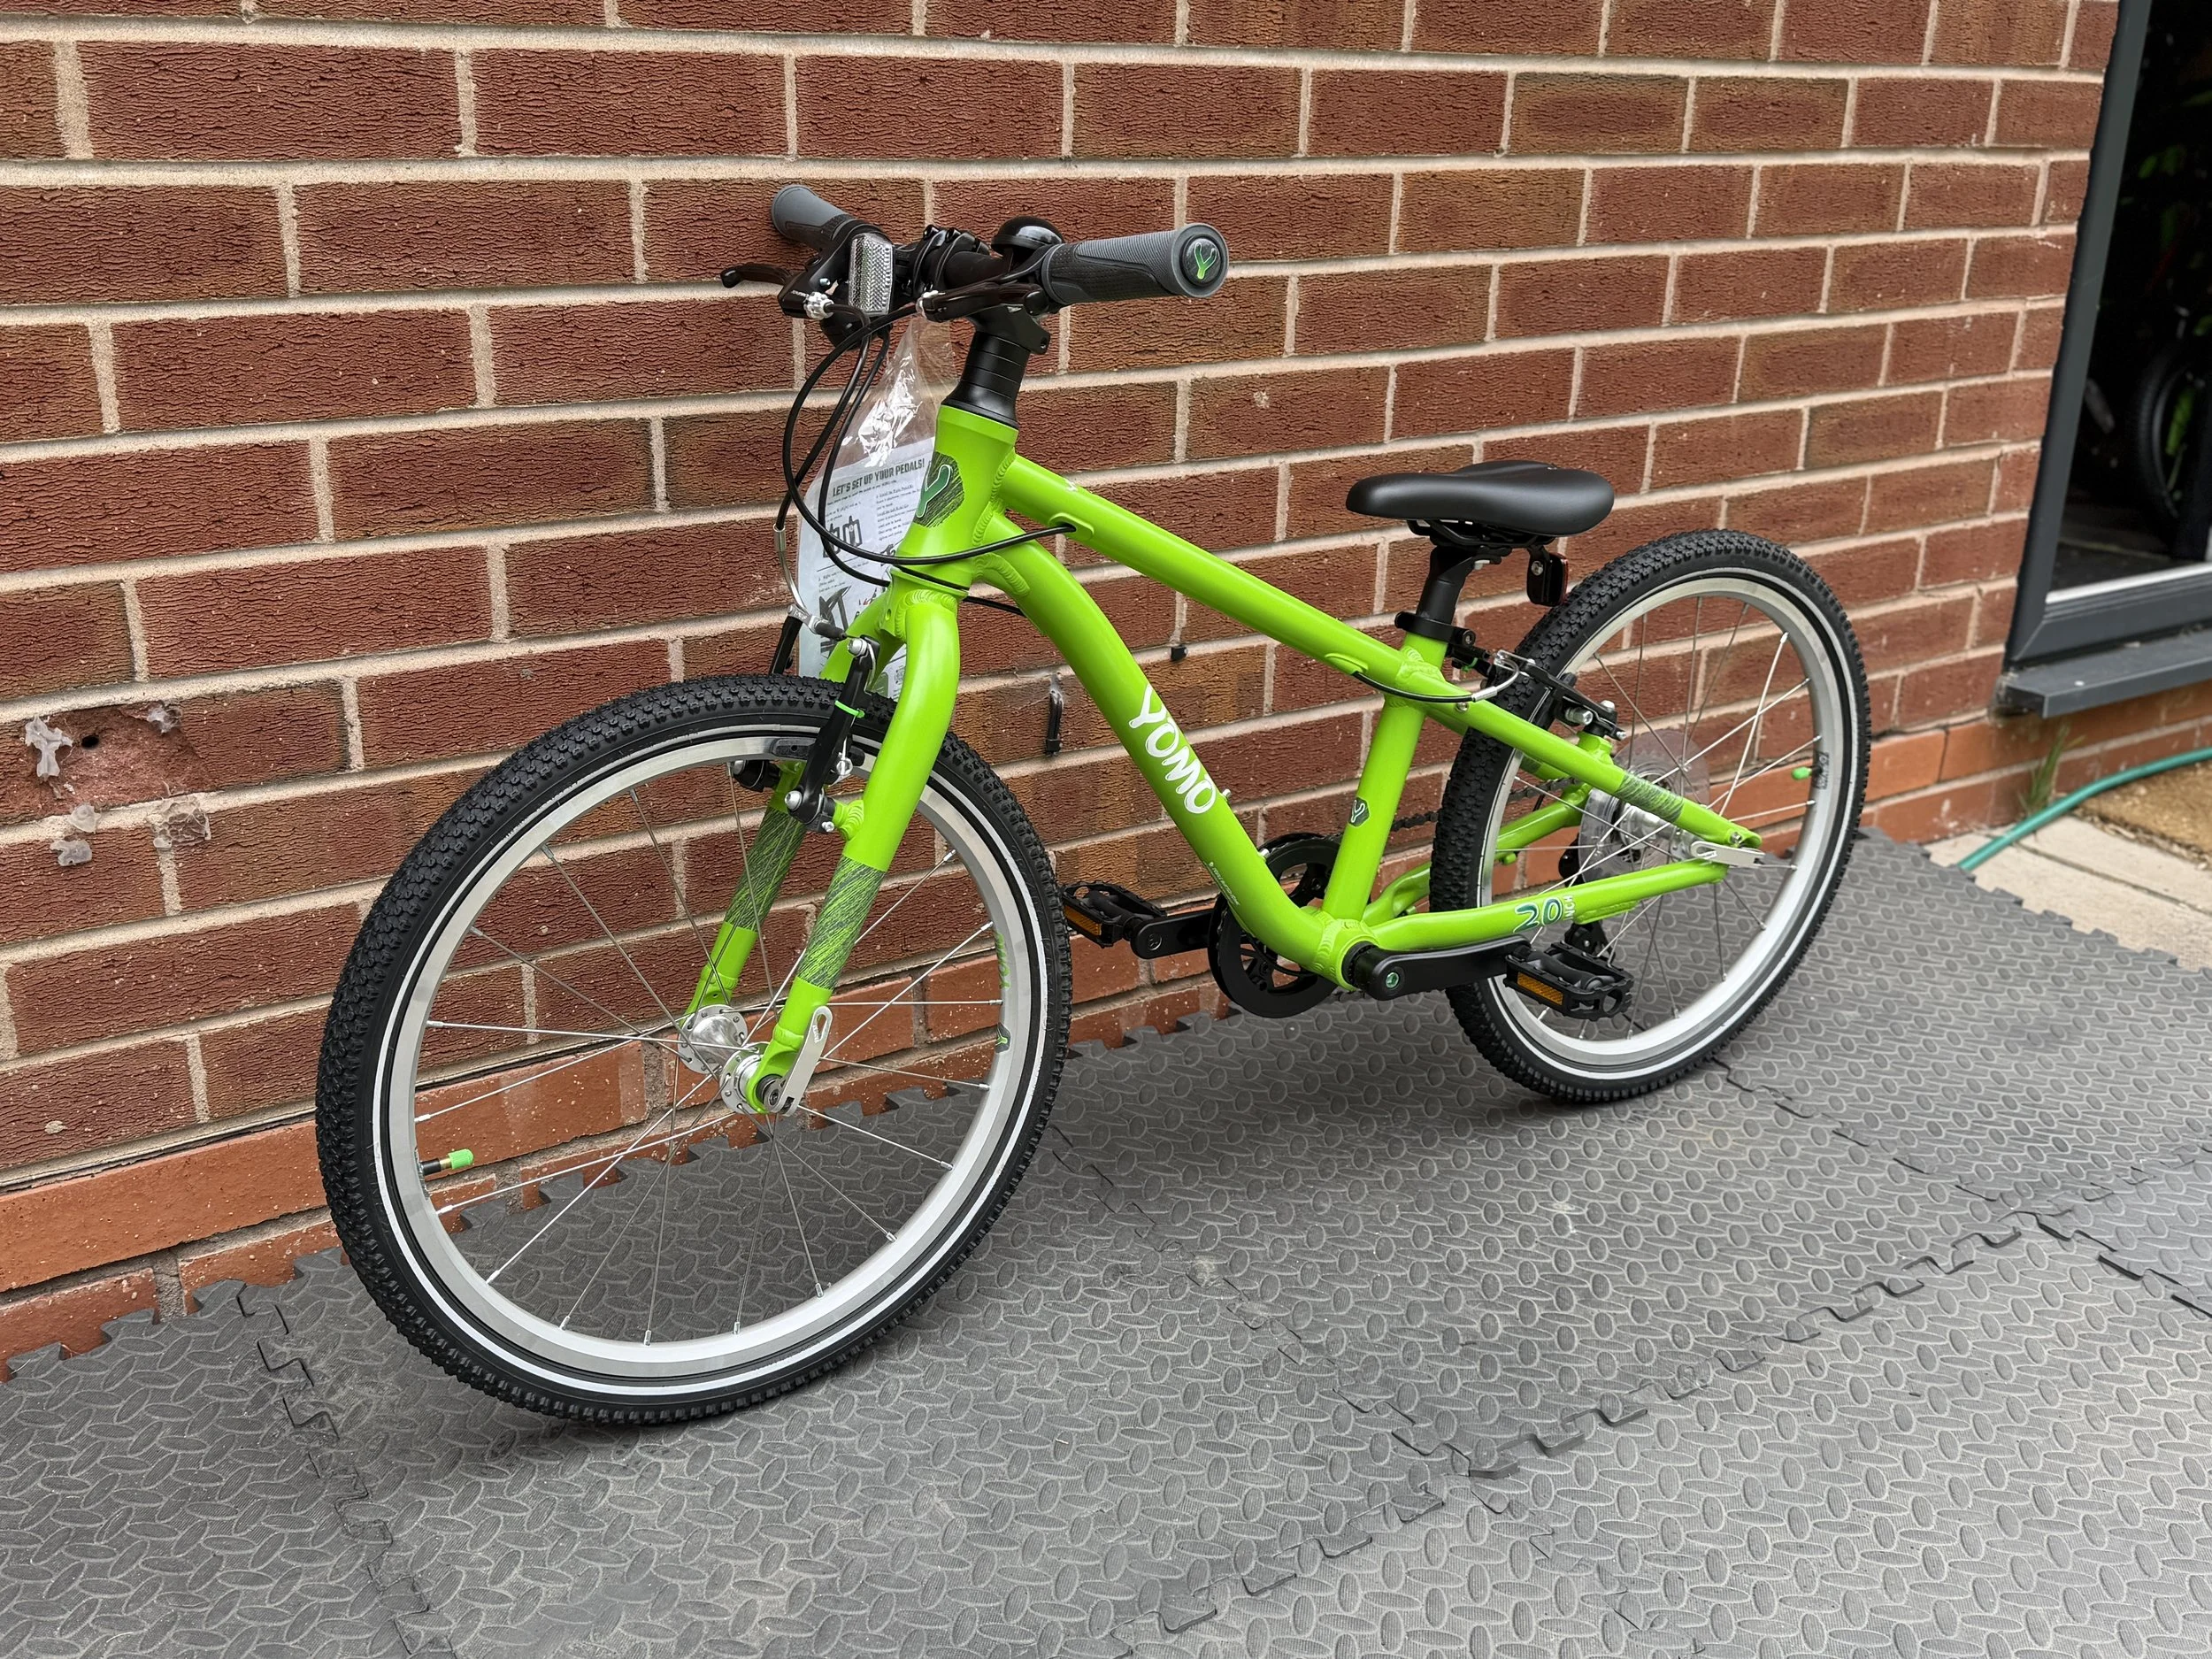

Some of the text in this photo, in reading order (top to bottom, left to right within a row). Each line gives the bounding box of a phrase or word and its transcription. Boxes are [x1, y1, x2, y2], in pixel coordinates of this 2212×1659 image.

[833, 482, 850, 497] LET'S
[851, 477, 864, 488] SET
[864, 472, 873, 484] UP
[874, 466, 895, 481] YOUR
[895, 458, 925, 476] PEDALS!
[1128, 683, 1217, 814] YOMO
[1513, 895, 1575, 933] 20 INCH
